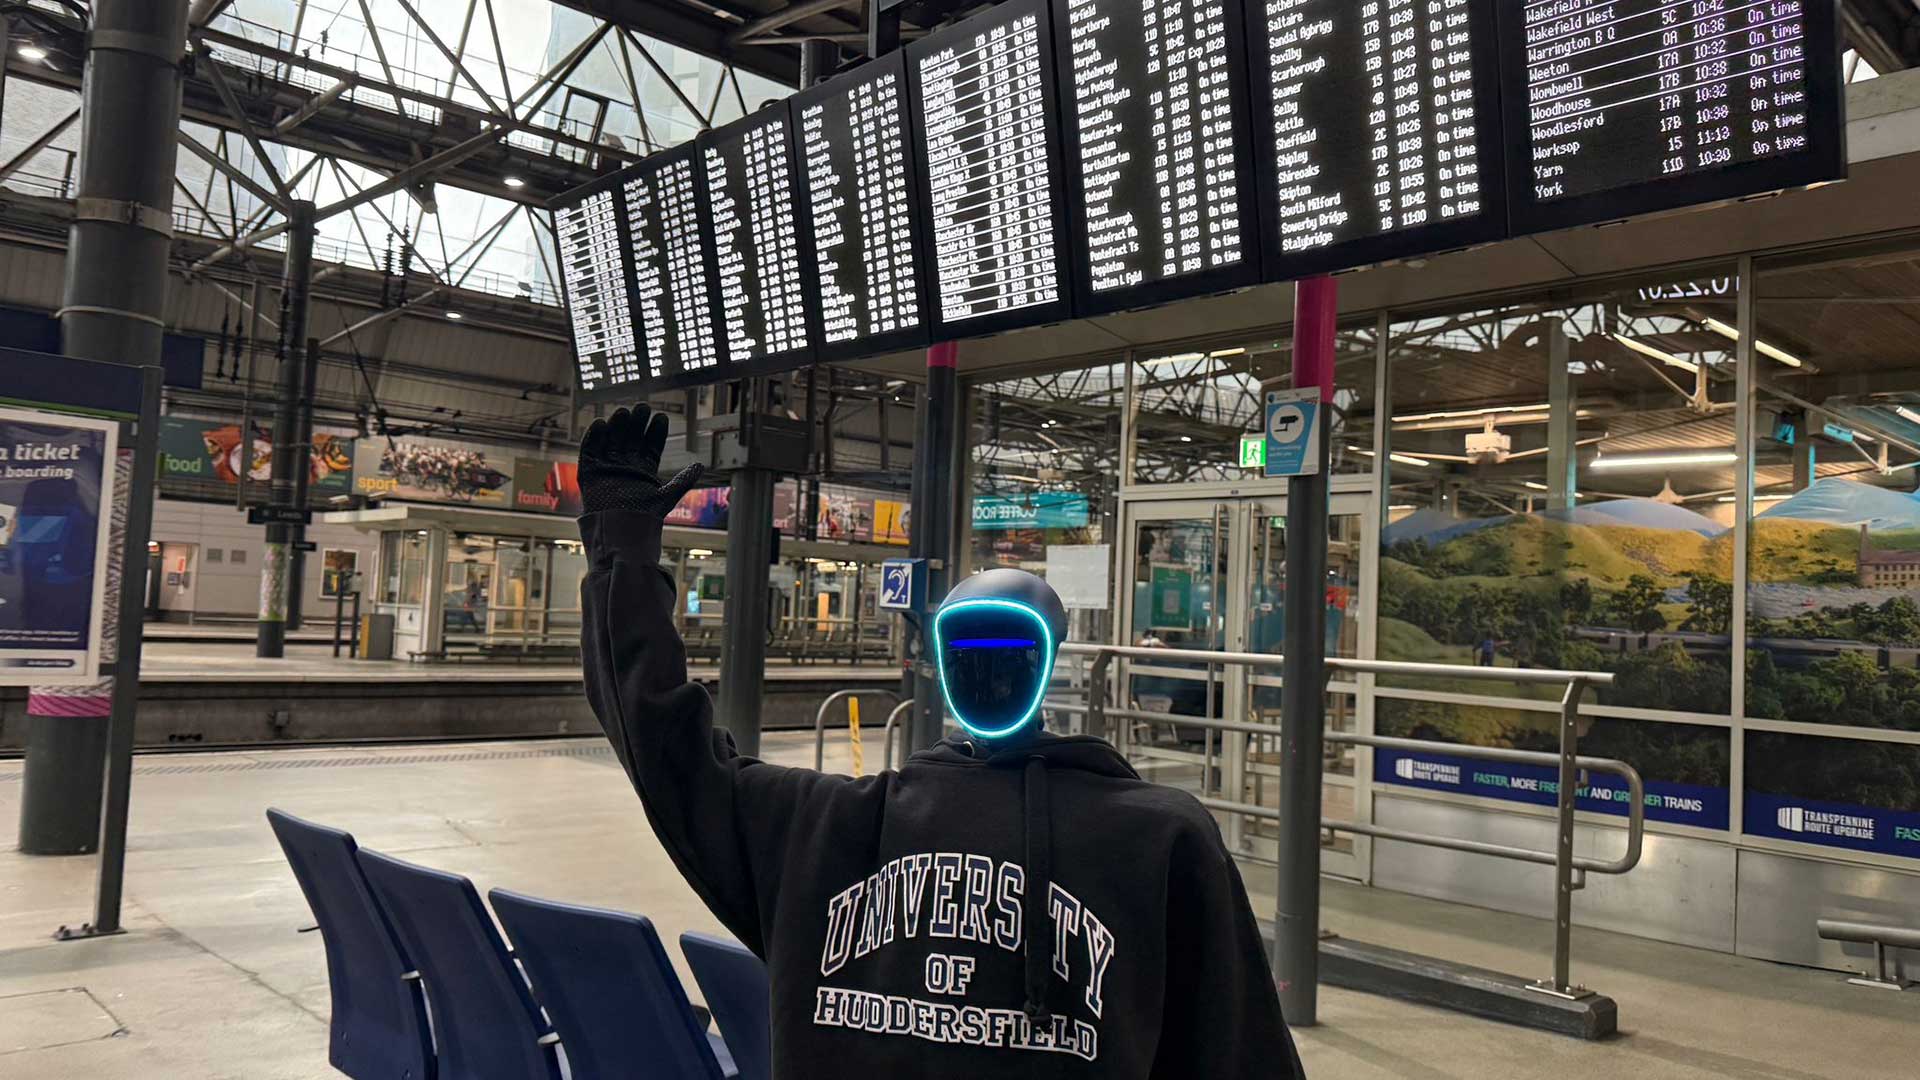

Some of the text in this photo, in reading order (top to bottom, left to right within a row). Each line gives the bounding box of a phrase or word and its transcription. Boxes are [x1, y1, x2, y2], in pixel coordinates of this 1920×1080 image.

[1428, 0, 1441, 14] On
[1526, 0, 1580, 23] Wakefield
[1429, 19, 1442, 32] On
[1445, 12, 1467, 27] time
[1527, 6, 1615, 42] Wakefield West
[1528, 0, 1724, 63] Warrington B Q 5C 10:42
[1430, 38, 1443, 51] On
[1446, 31, 1468, 46] time
[1529, 62, 1569, 82] Weeton
[1693, 17, 1725, 38] 10:36
[1747, 8, 1764, 23] On
[1770, 1, 1799, 16] time
[1432, 56, 1445, 70] On
[1447, 50, 1470, 64] time
[1530, 23, 1800, 102] Wombwell 17A 10:32 On time
[1433, 75, 1446, 88] On
[1448, 69, 1471, 83] time
[1531, 45, 1801, 121] Woodhouse 17B 10:38 On time
[1434, 94, 1447, 106] On
[1450, 88, 1472, 102] time
[1531, 69, 1800, 141] Woodlesford 17A 10:32 On time
[1435, 112, 1448, 125] On
[1451, 107, 1473, 121] time
[1532, 91, 1803, 160] Worksop 17B 10:38 On time
[1436, 130, 1449, 144] On
[1452, 126, 1474, 139] time
[1437, 149, 1451, 162] On
[1453, 144, 1476, 158] time
[1533, 165, 1563, 179] Yarm
[1668, 135, 1682, 151] 15
[1752, 119, 1768, 133] On
[1773, 113, 1804, 128] time
[1439, 167, 1452, 180] On
[1454, 163, 1477, 176] time
[1534, 181, 1563, 198] York
[1752, 140, 1769, 154] On
[1775, 135, 1805, 150] time
[1440, 186, 1453, 198] On
[1455, 181, 1478, 195] time
[1441, 204, 1454, 217] On
[1457, 200, 1479, 213] time
[15, 442, 80, 460] ticket
[5, 465, 74, 480] boarding
[164, 454, 202, 473] food
[358, 476, 398, 492] sport
[518, 489, 559, 510] family
[1473, 772, 1510, 788] FASTER,
[1511, 777, 1538, 791] MORE
[1590, 787, 1612, 800] AND
[1613, 790, 1662, 807] GRENER
[1664, 796, 1703, 812] TRAINS
[1804, 810, 1875, 829] TRANSPENNINE
[1804, 821, 1875, 840] ROUTE UPGRADE
[821, 852, 1115, 1019] UNIVERSTY
[925, 952, 975, 995] OF
[814, 986, 1097, 1062] HUDDERSFIELD
